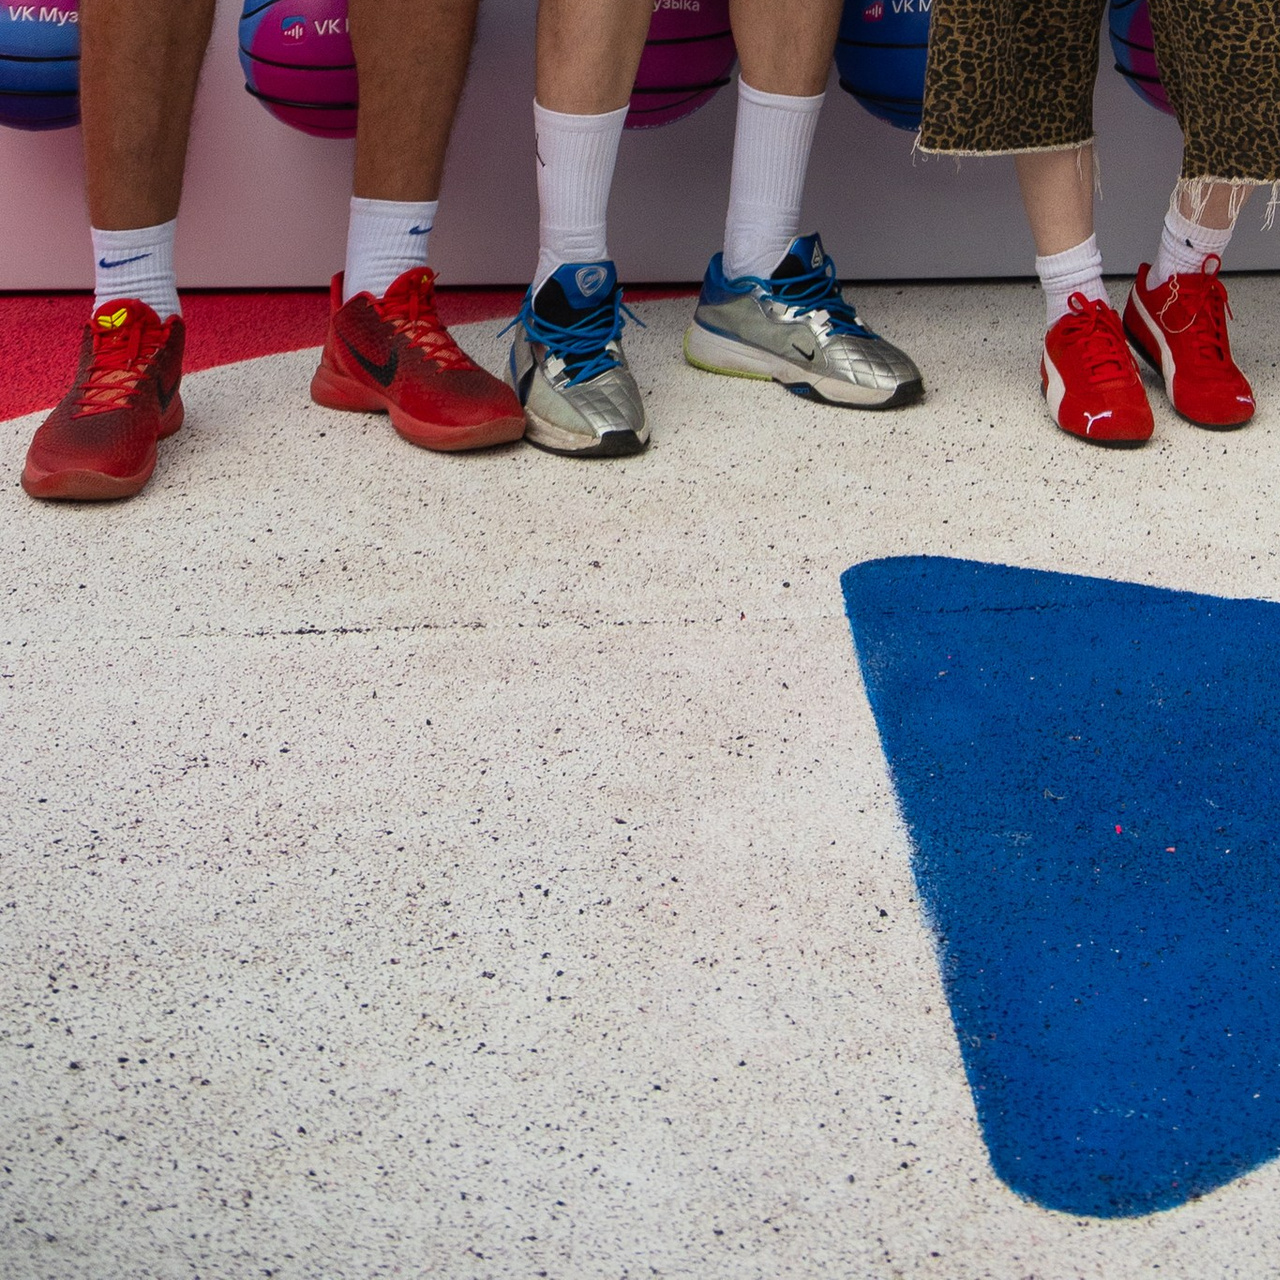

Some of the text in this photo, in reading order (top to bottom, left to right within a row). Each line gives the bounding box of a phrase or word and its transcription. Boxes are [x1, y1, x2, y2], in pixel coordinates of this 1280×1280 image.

[9, 5, 79, 26] VK Муз
[314, 18, 341, 35] VK
